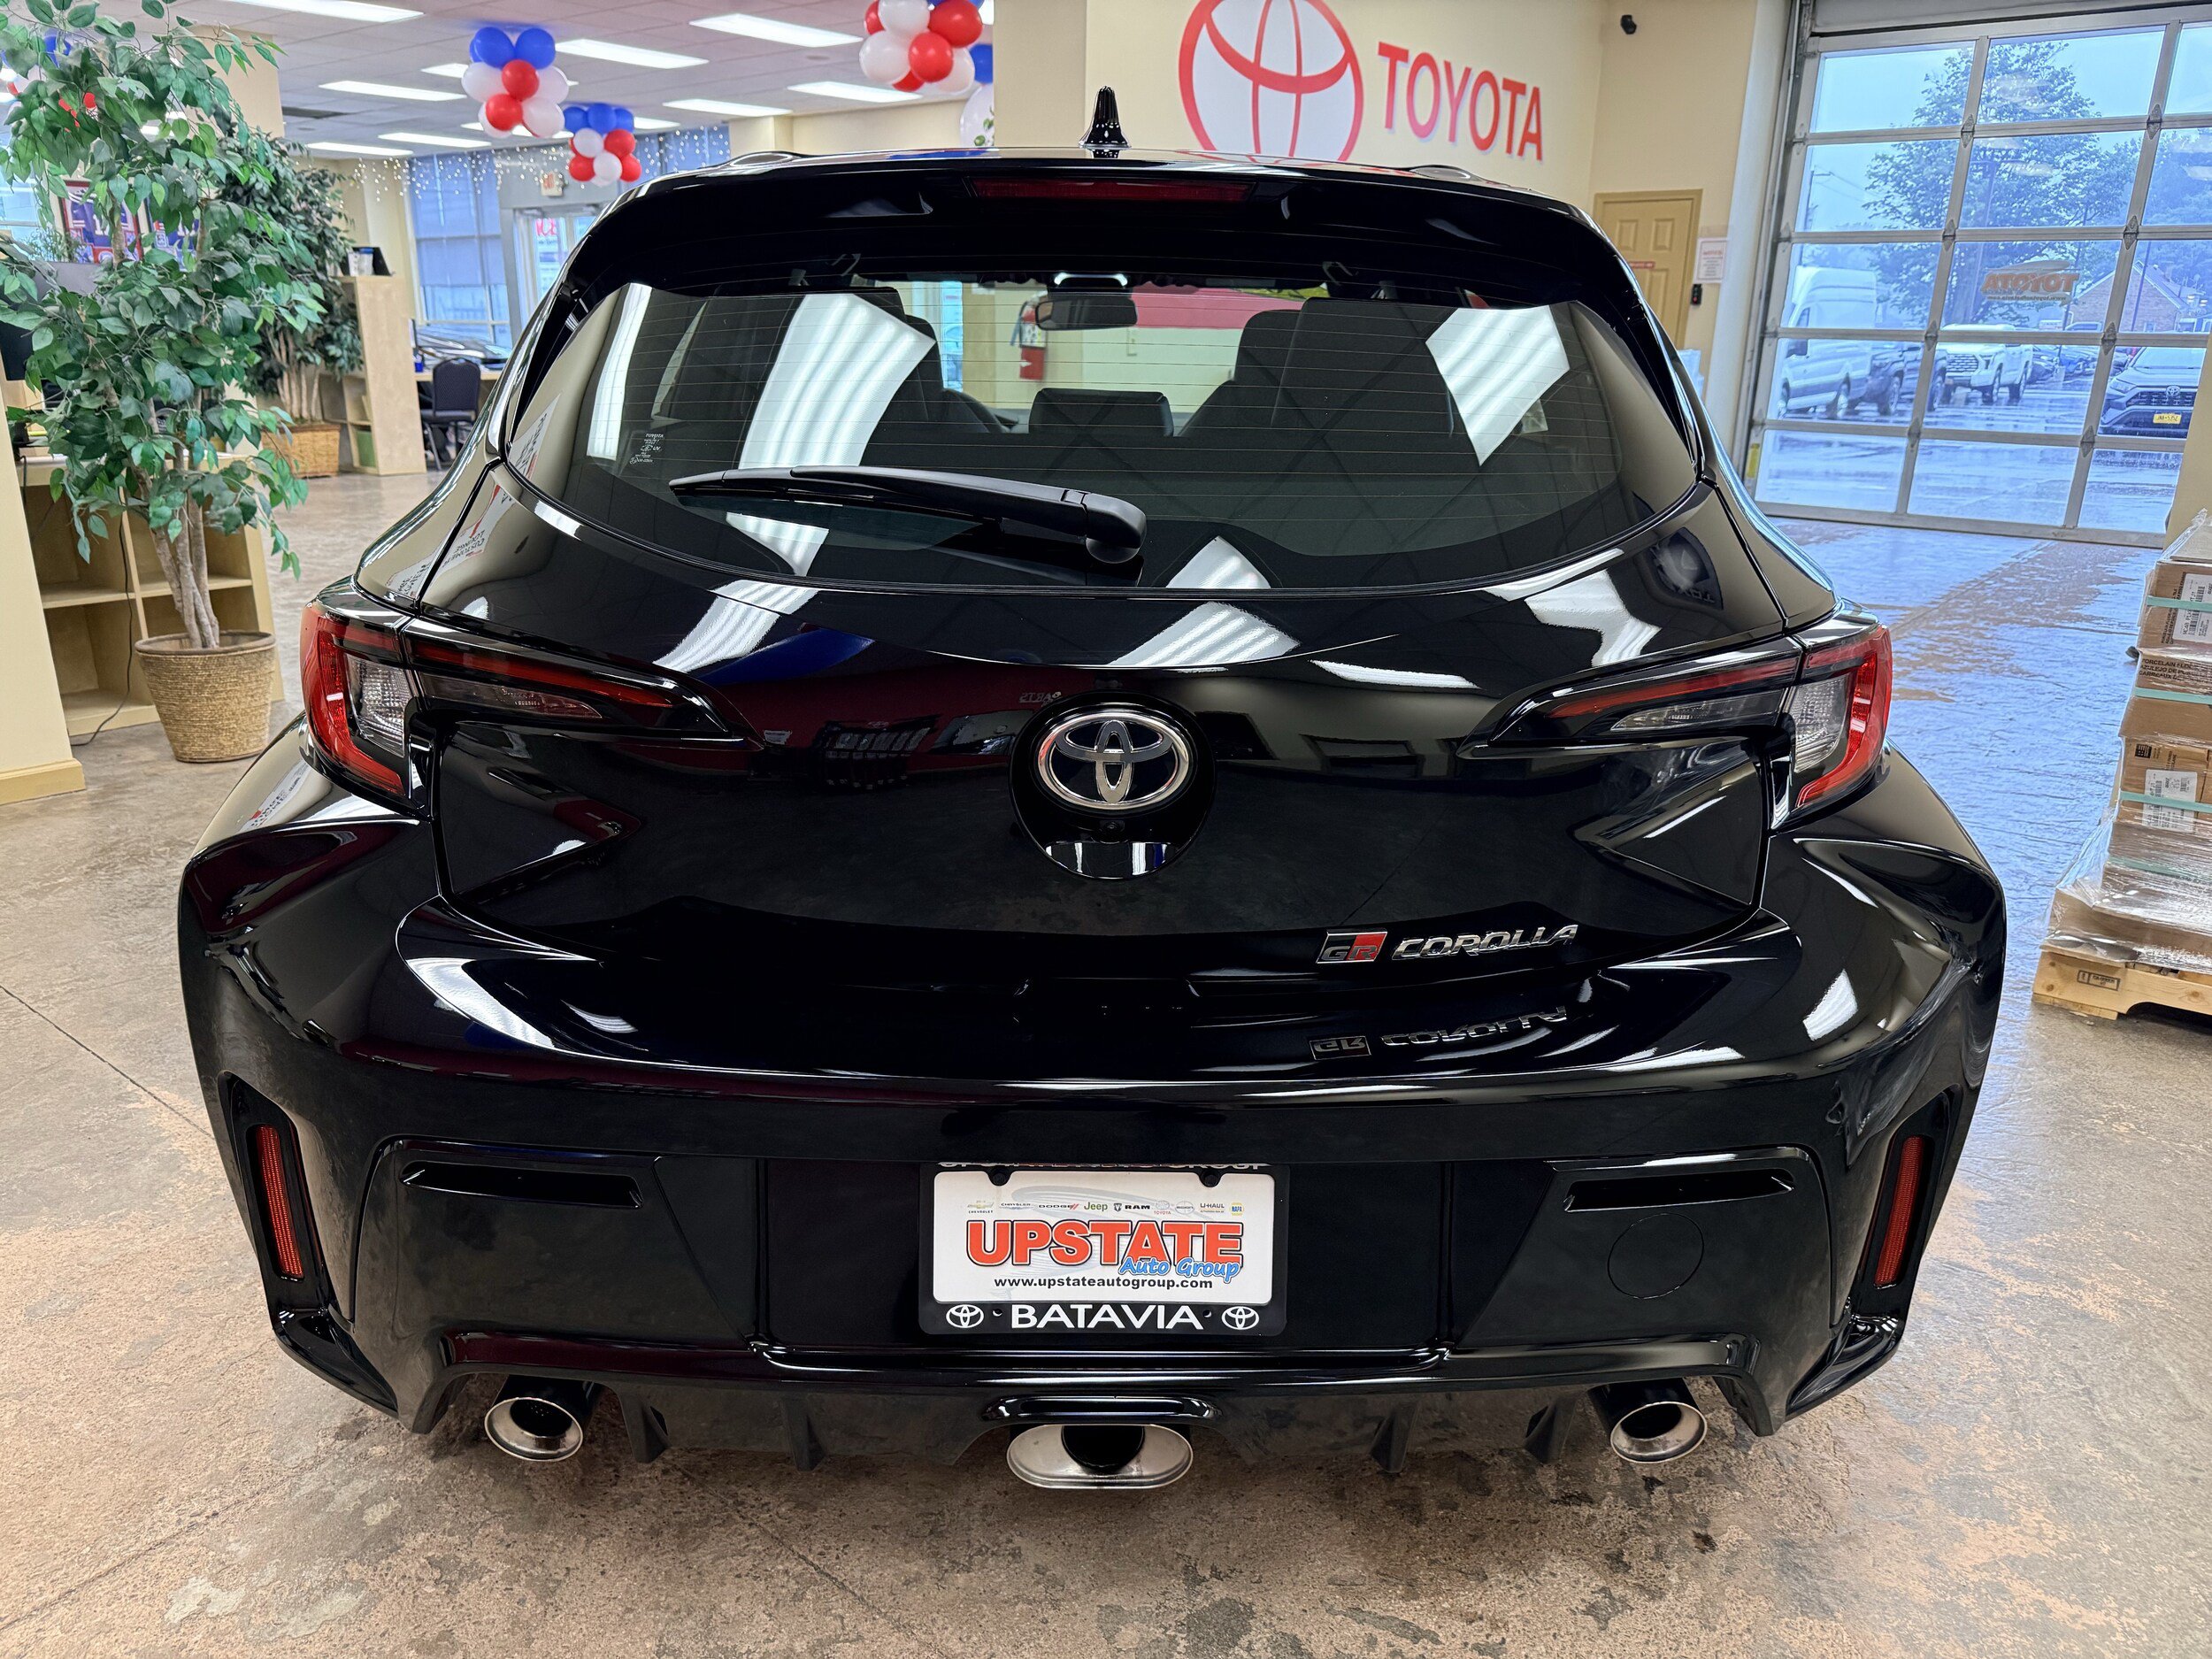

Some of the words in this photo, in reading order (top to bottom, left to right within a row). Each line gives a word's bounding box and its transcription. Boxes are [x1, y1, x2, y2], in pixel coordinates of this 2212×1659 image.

[1378, 41, 1543, 161] TOYOTA
[1321, 945, 1378, 961] GR
[1392, 924, 1578, 961] COROLLA
[1084, 1202, 1108, 1212] Jeep
[966, 1219, 1244, 1267] UPSTATE
[995, 1277, 1213, 1289] www.upstateautogroup.com
[1118, 1256, 1171, 1276] Auto
[1175, 1257, 1242, 1283] Group
[1011, 1304, 1204, 1330] BATAVIA
